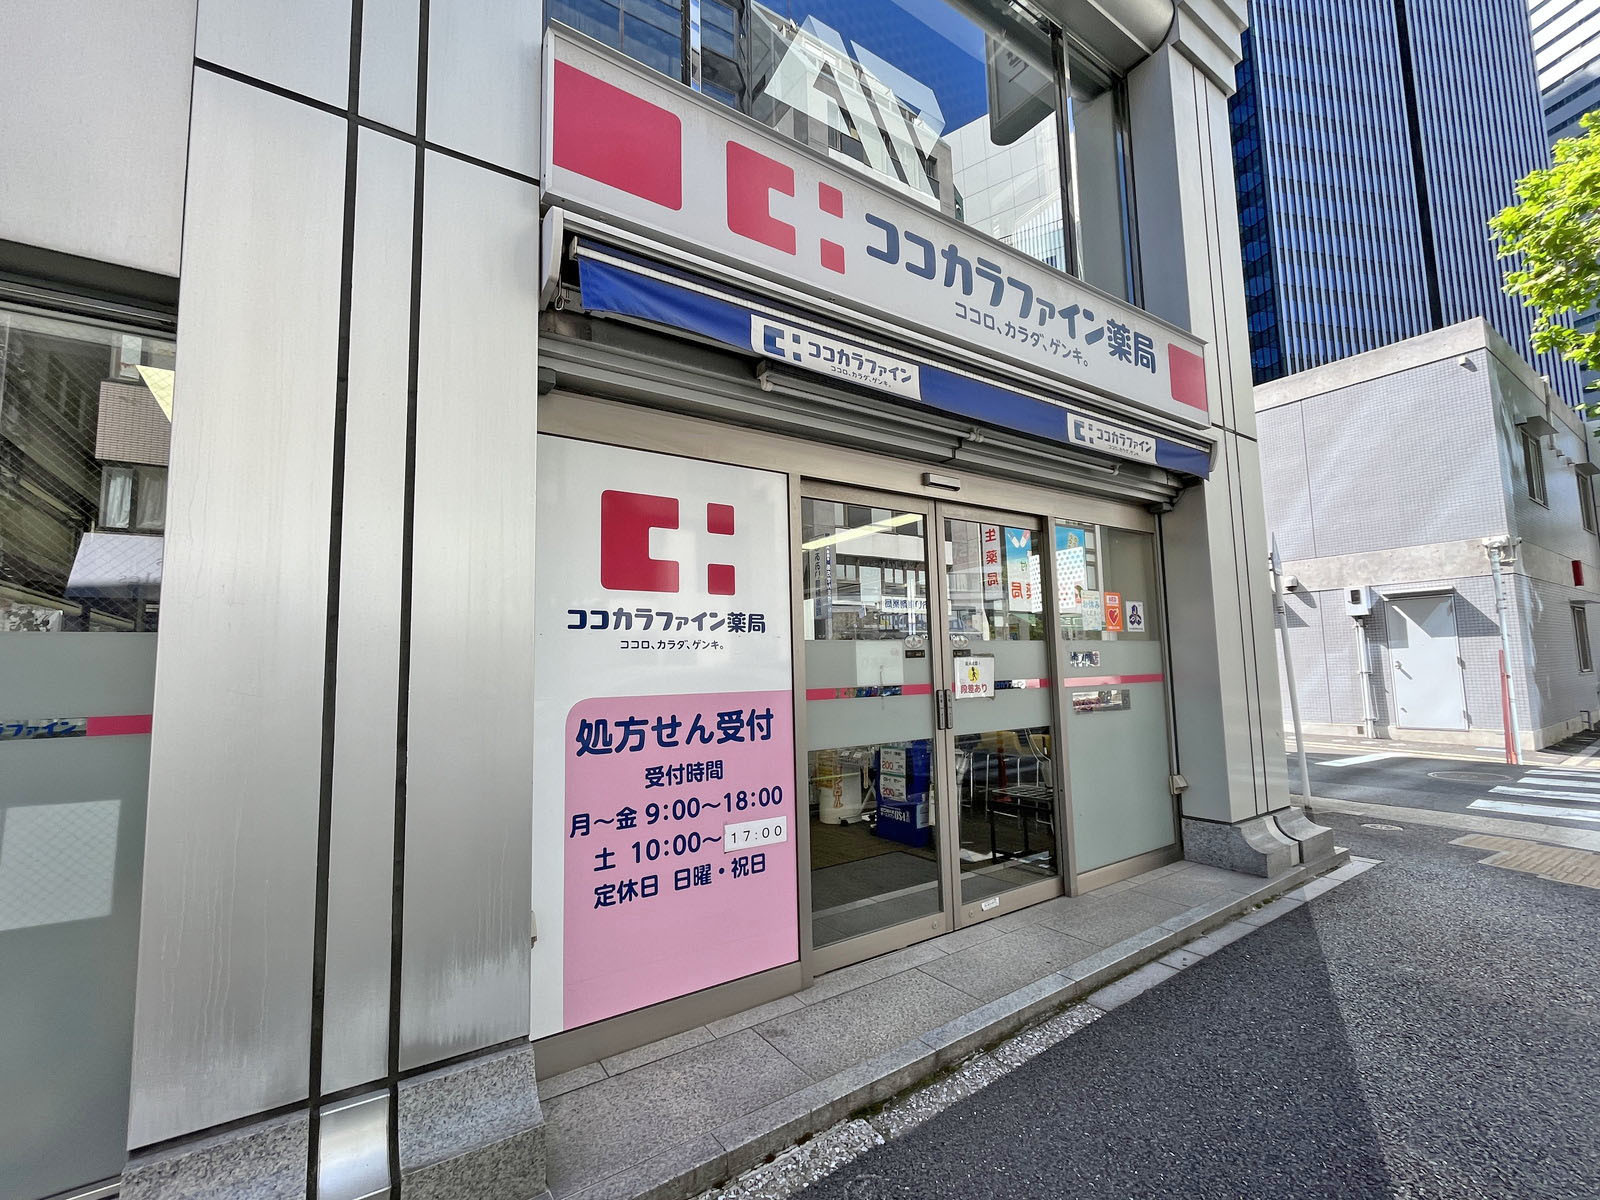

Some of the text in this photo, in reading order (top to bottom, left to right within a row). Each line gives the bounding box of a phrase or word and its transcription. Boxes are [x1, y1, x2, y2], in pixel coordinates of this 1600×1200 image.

[865, 212, 1157, 374] ココカラファイン薬局
[955, 301, 1089, 367] ココロ、カラダ、ゲンキ。
[808, 341, 912, 383] ココカラファイン
[831, 365, 892, 388] ココロ、カラダ、ゲンキ。
[1096, 428, 1152, 453] ココカラファイン
[567, 608, 766, 634] ココカラファイン薬局
[620, 639, 724, 650] ココロ、カラダ、ゲンキ。
[960, 683, 988, 694] 段差あり
[0, 721, 78, 738] ファイン
[576, 708, 774, 757] 処方せん受付
[645, 760, 724, 789] 受付時間
[593, 848, 616, 872] 土
[731, 825, 783, 844] 17:00
[594, 853, 766, 909] 定休日 日曜・祝日
